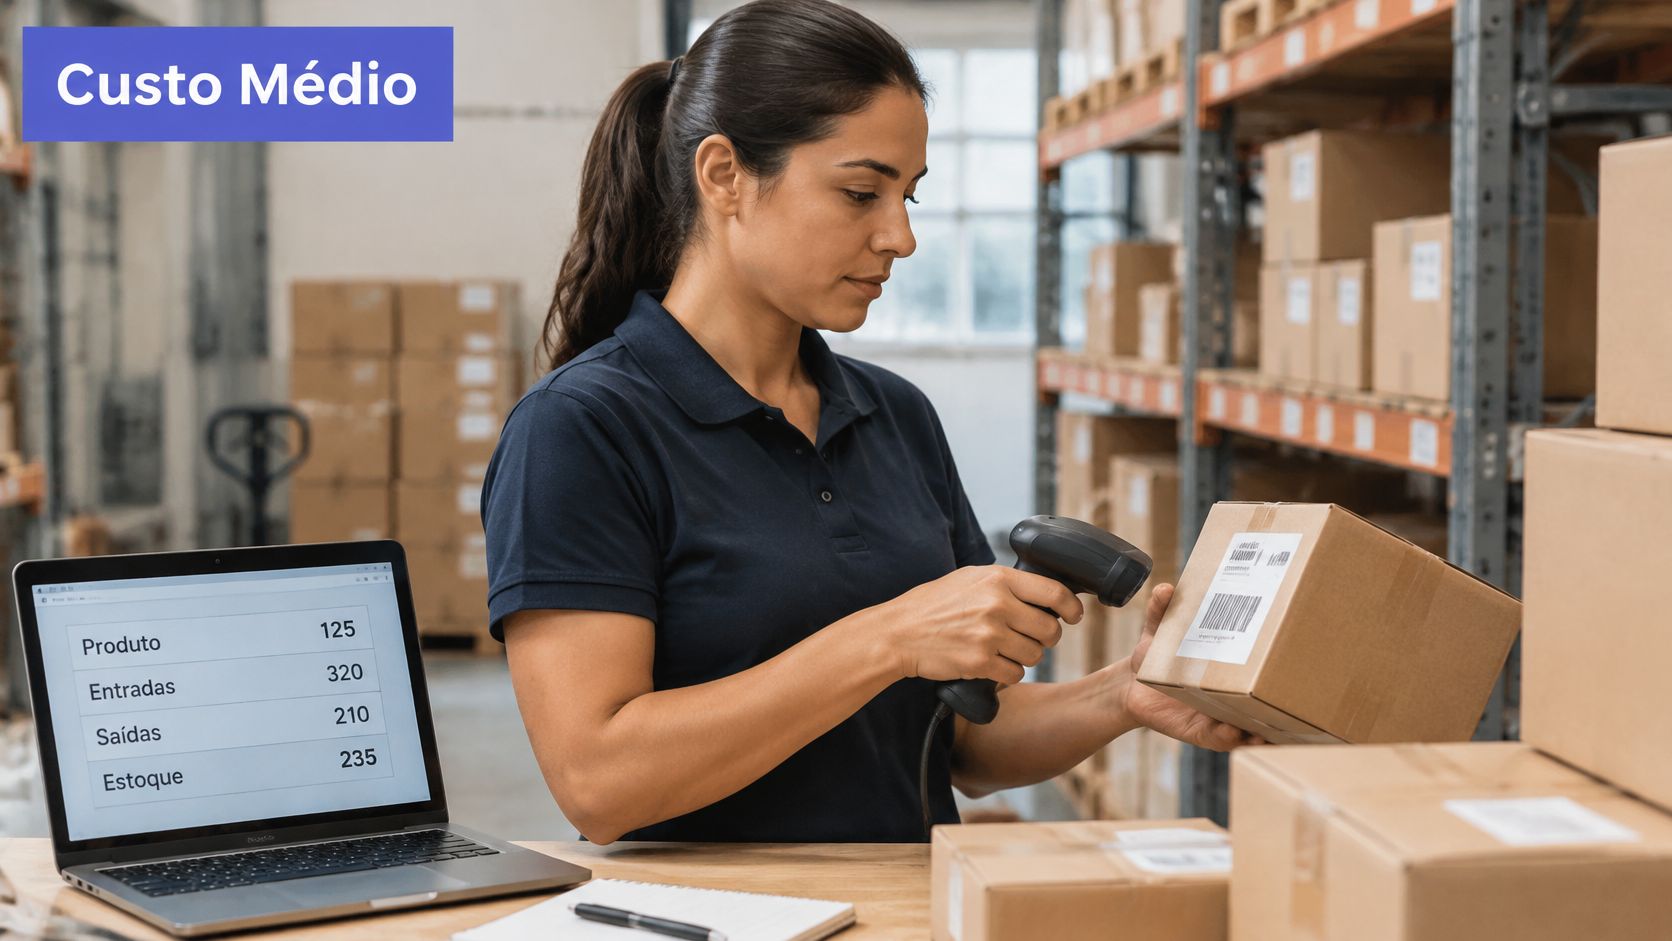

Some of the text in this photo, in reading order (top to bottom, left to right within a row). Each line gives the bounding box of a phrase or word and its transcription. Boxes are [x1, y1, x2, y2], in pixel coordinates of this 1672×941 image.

[82, 619, 356, 656] Produto 125
[89, 663, 364, 701] Entradas 320
[96, 705, 370, 746] Saídas 210
[103, 748, 377, 792] Estoque 235
